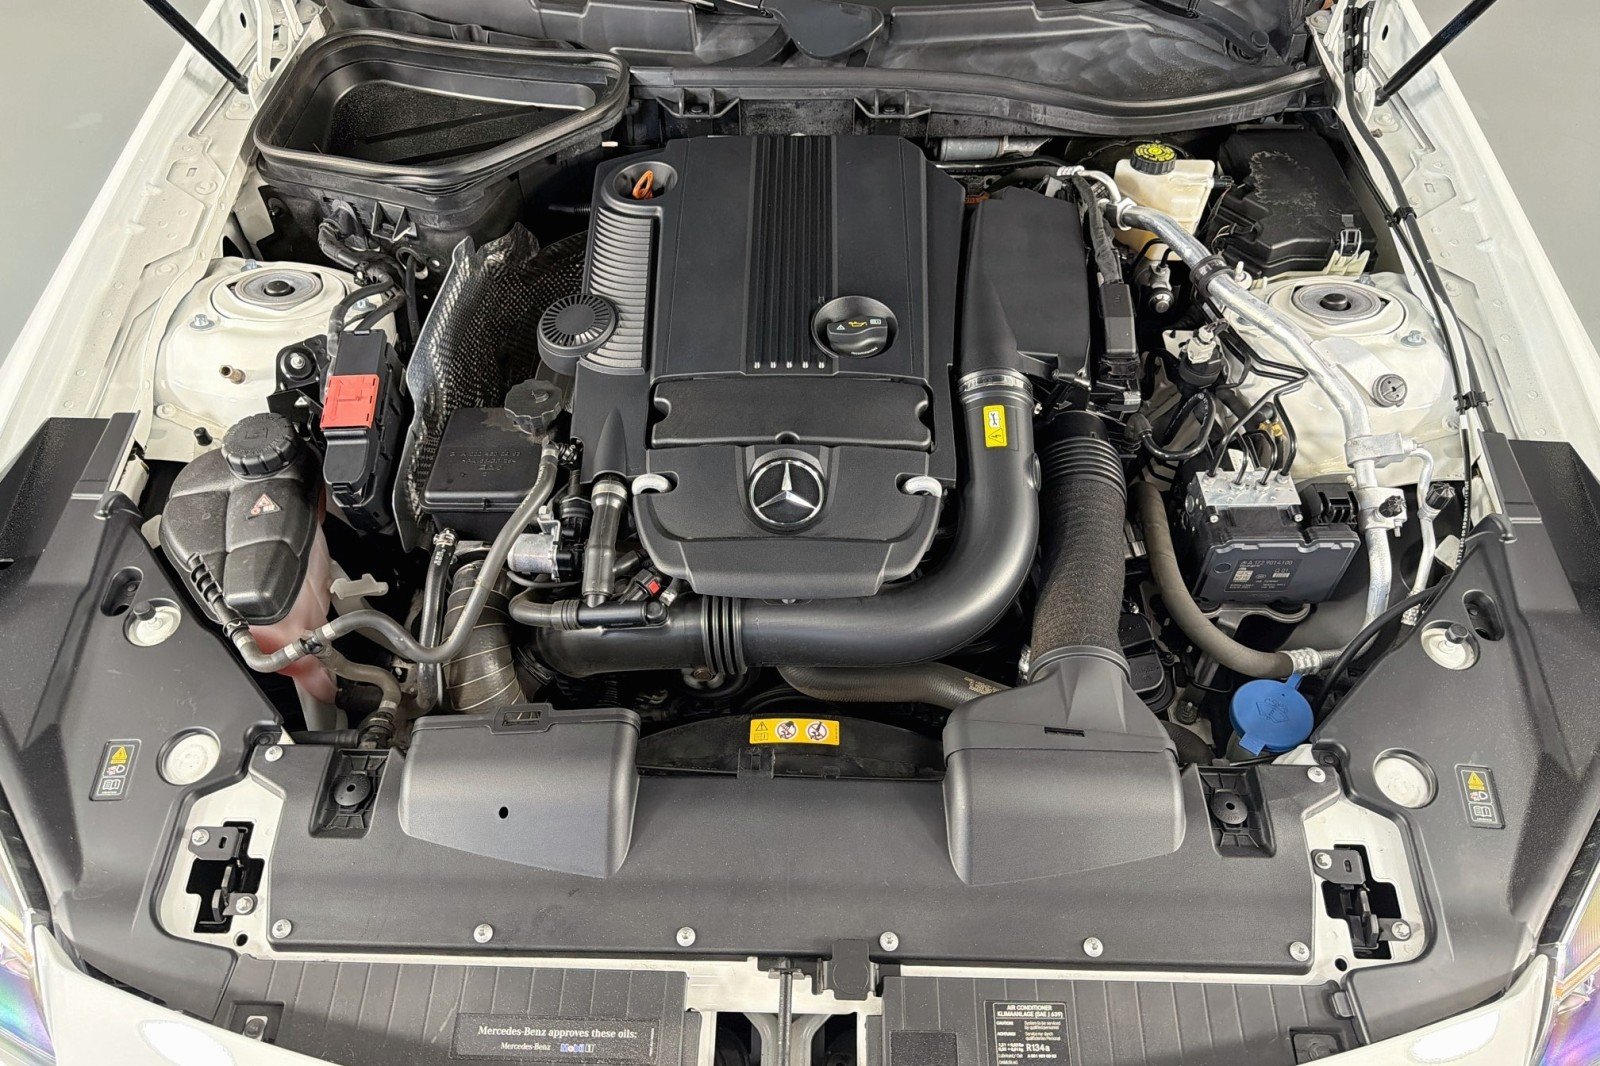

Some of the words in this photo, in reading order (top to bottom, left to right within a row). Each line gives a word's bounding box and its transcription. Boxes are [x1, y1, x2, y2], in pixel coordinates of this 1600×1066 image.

[478, 1025, 547, 1037] Mercedes-Benz
[548, 1028, 589, 1039] approves
[591, 1028, 616, 1038] these
[617, 1028, 638, 1038] oils:
[500, 1042, 552, 1050] Mercedes-Benz
[560, 1043, 584, 1052] Mobil
[1025, 1043, 1051, 1052] R134a
